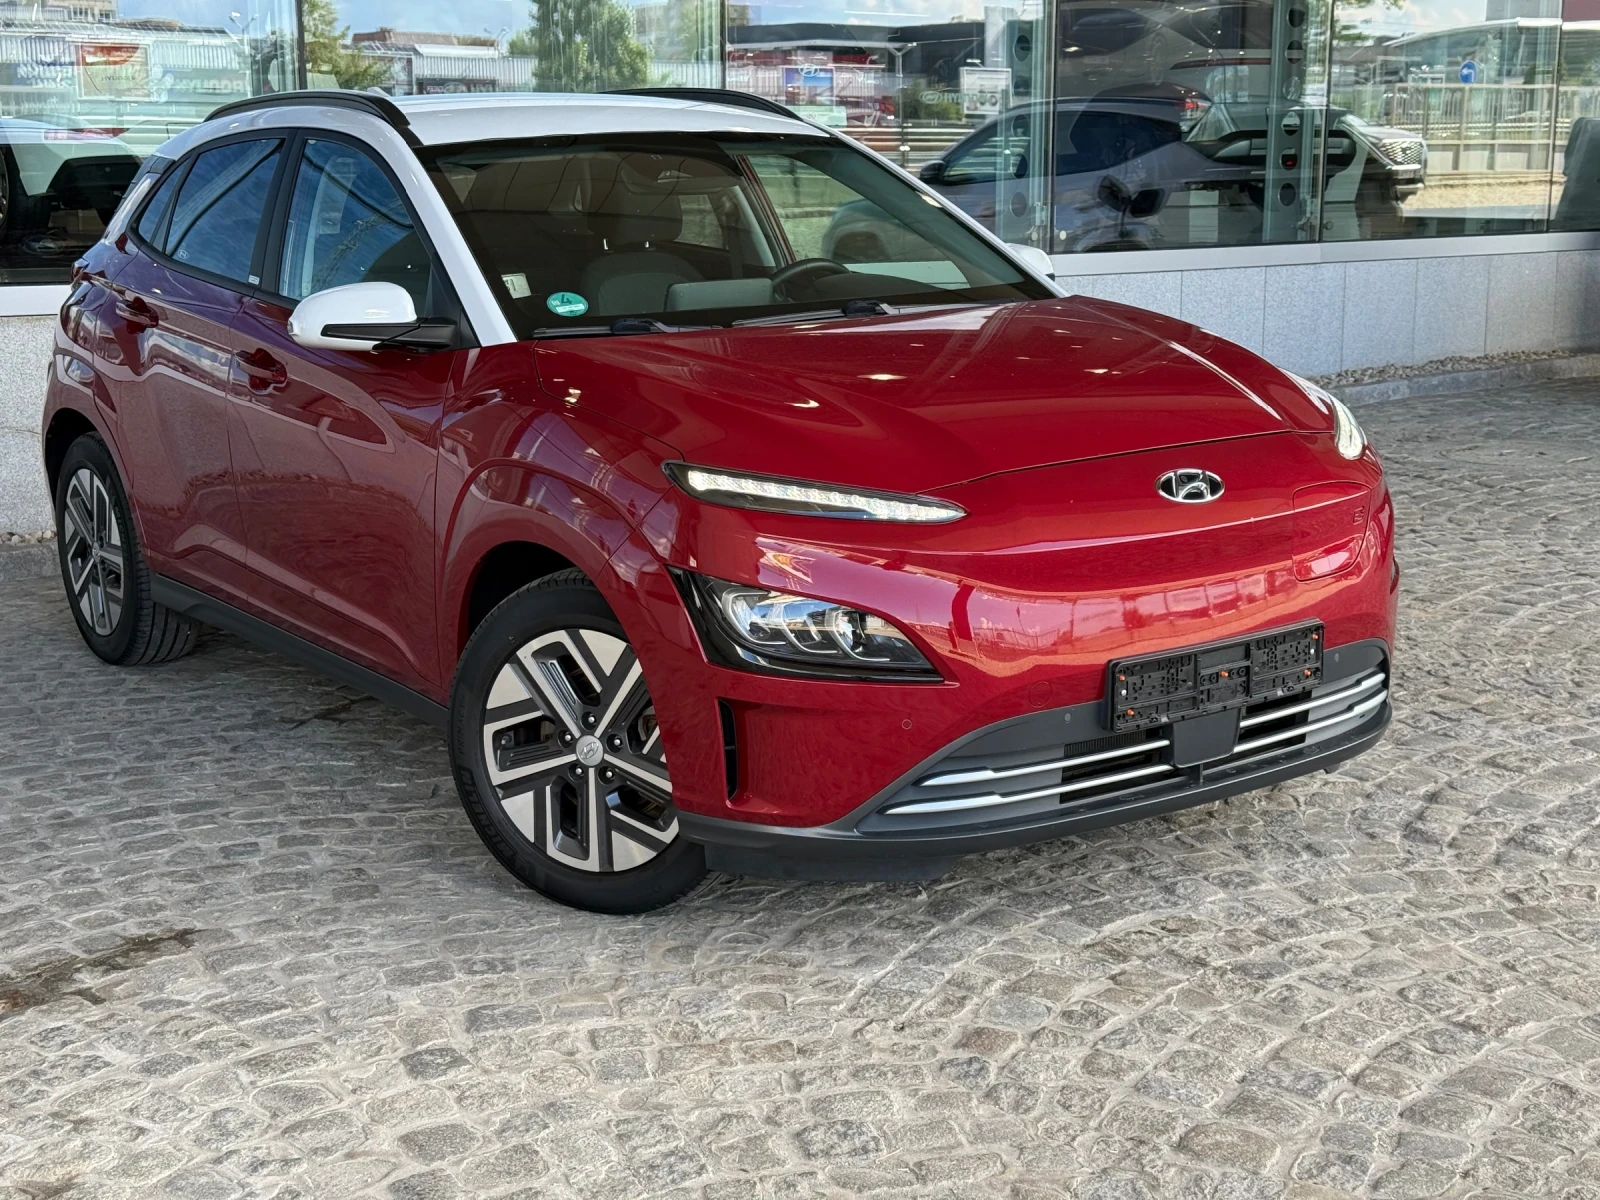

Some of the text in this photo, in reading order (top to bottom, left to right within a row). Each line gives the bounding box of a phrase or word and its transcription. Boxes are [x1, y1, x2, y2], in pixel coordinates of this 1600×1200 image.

[561, 293, 573, 305] 4
[456, 703, 466, 756] PRIMACY
[460, 768, 516, 859] MICHELIN
